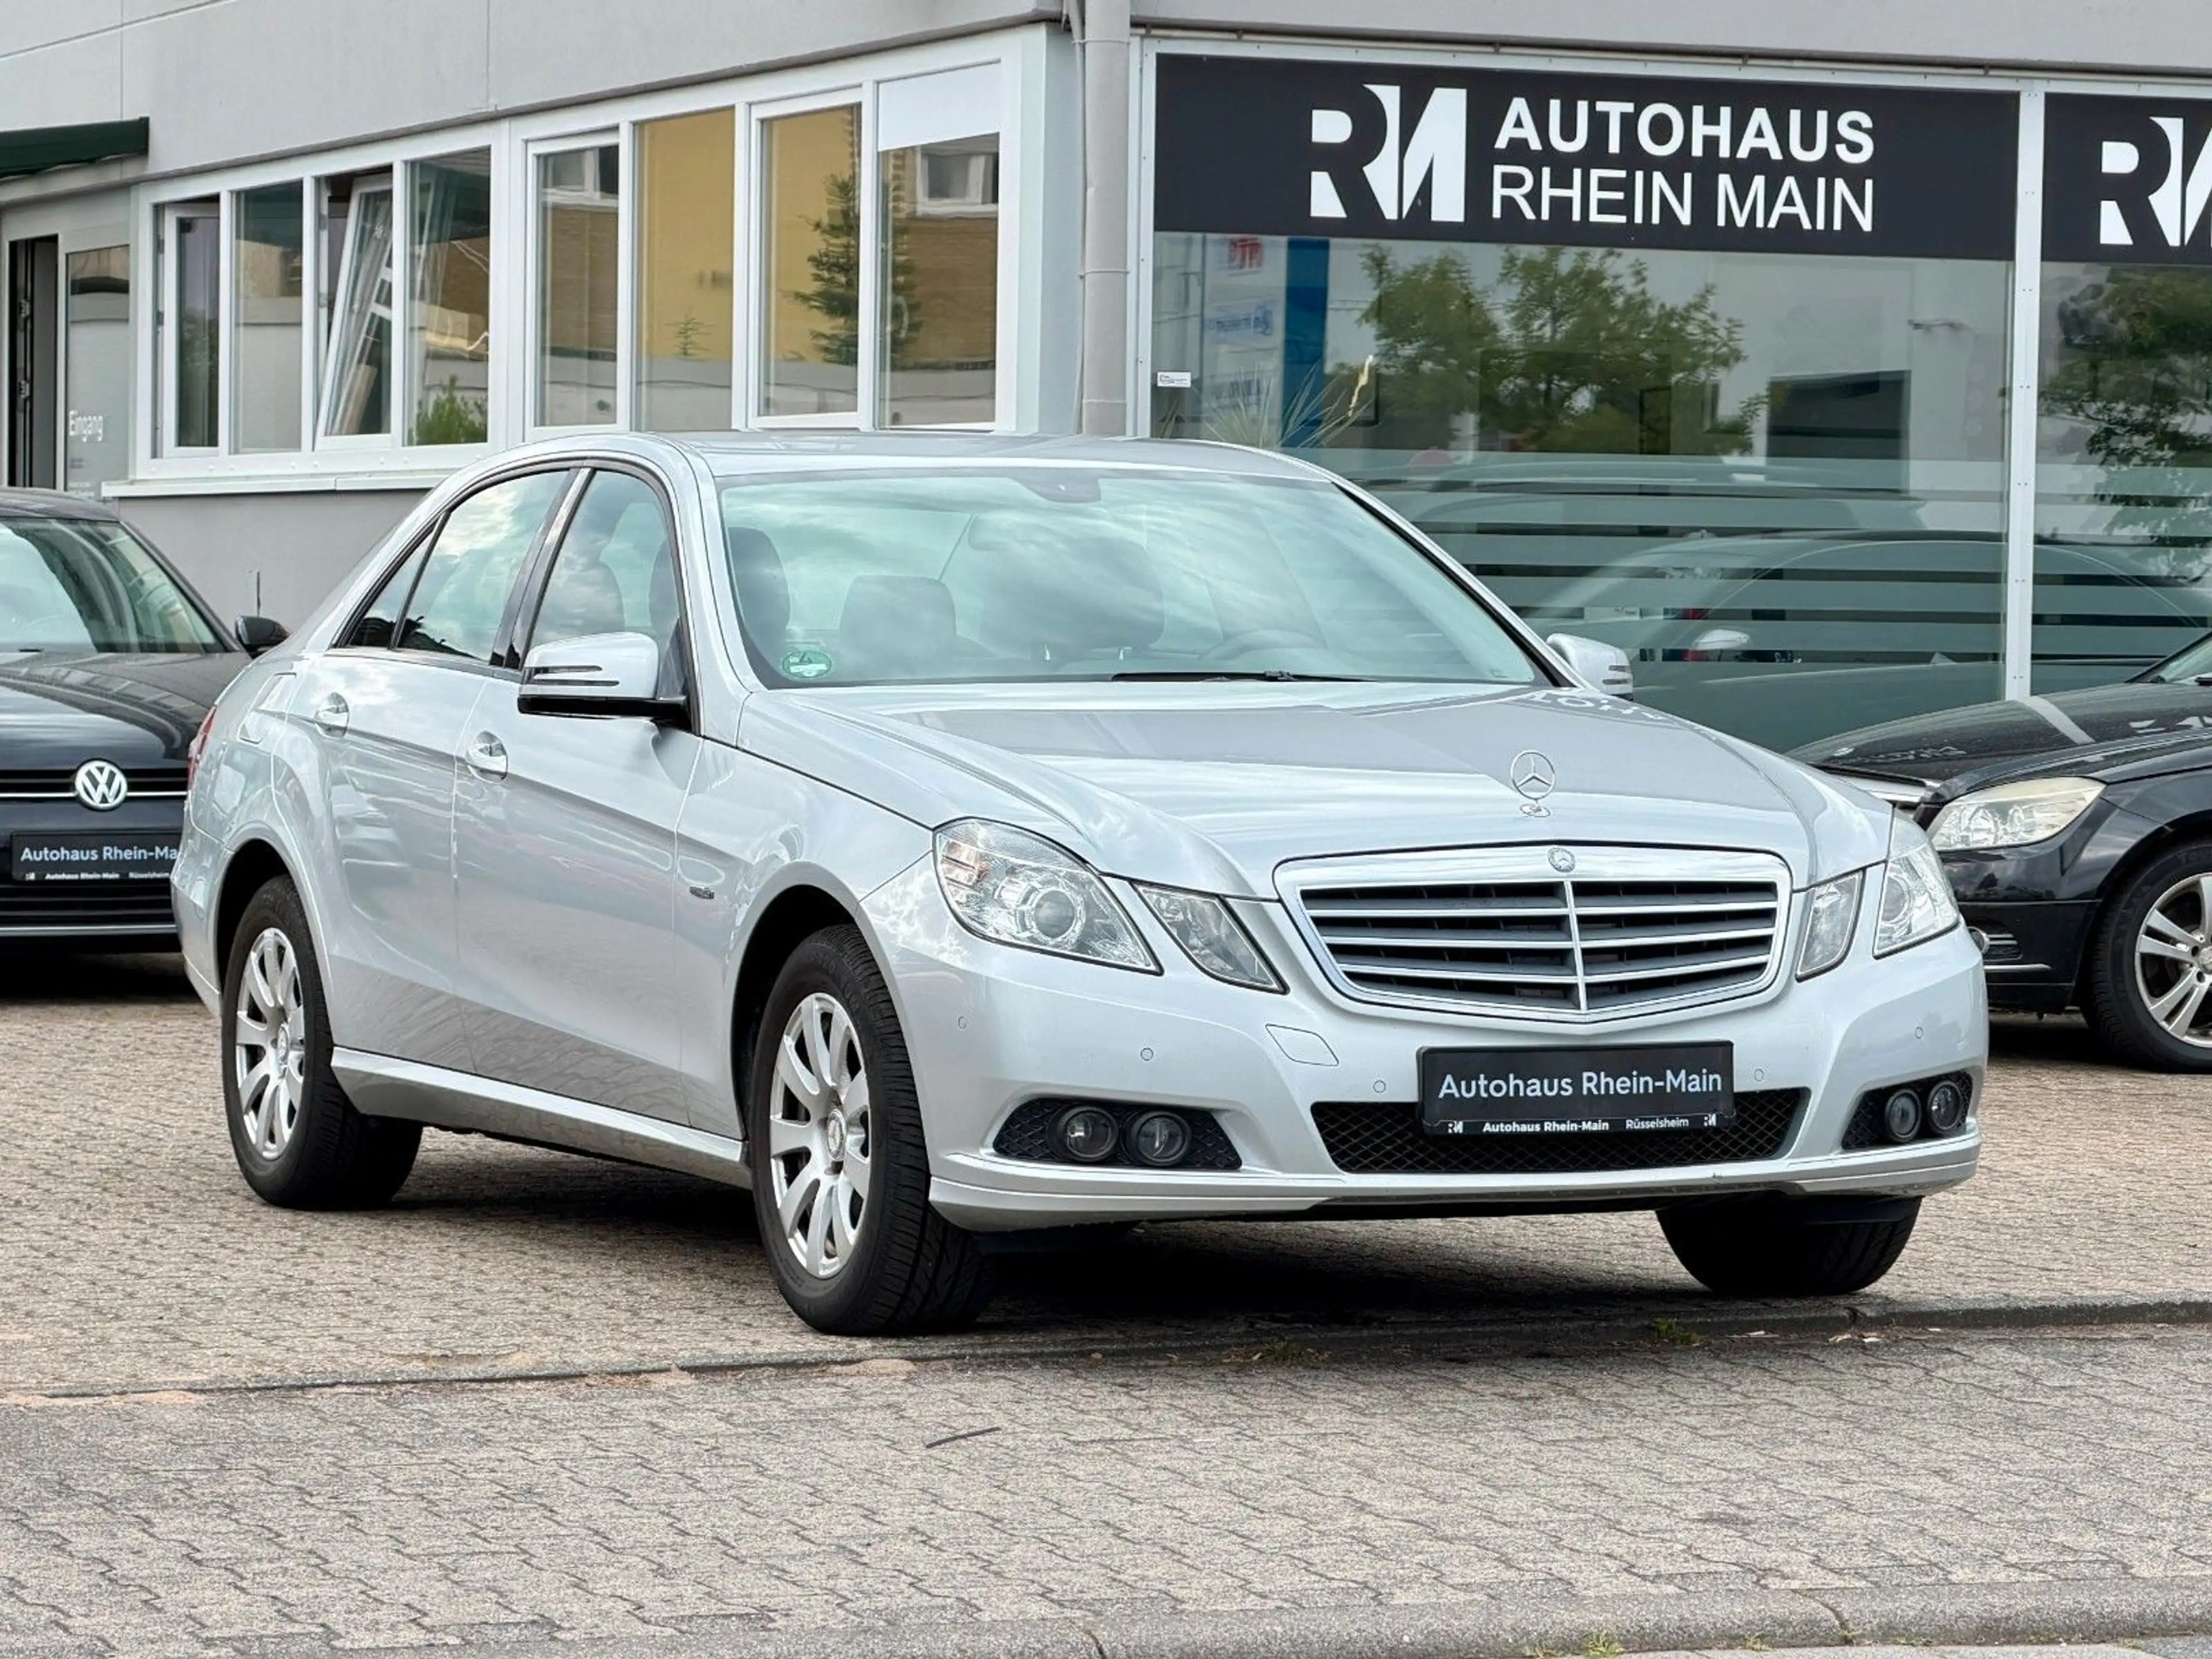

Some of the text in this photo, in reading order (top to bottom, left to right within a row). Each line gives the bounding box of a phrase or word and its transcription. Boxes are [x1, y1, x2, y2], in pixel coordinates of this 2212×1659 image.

[1309, 84, 1467, 223] RM
[1494, 96, 1874, 165] AUTOHAUS
[1491, 164, 1873, 232] RHEIN MAIN
[20, 845, 178, 861] Autohaus Rhein-Ma
[1438, 1067, 1722, 1099] Autohaus Rhein-Main
[1482, 1122, 1540, 1132] Autohaus
[1544, 1119, 1609, 1131] Rhein-Main
[1626, 1117, 1689, 1130] Rüsselsheim
